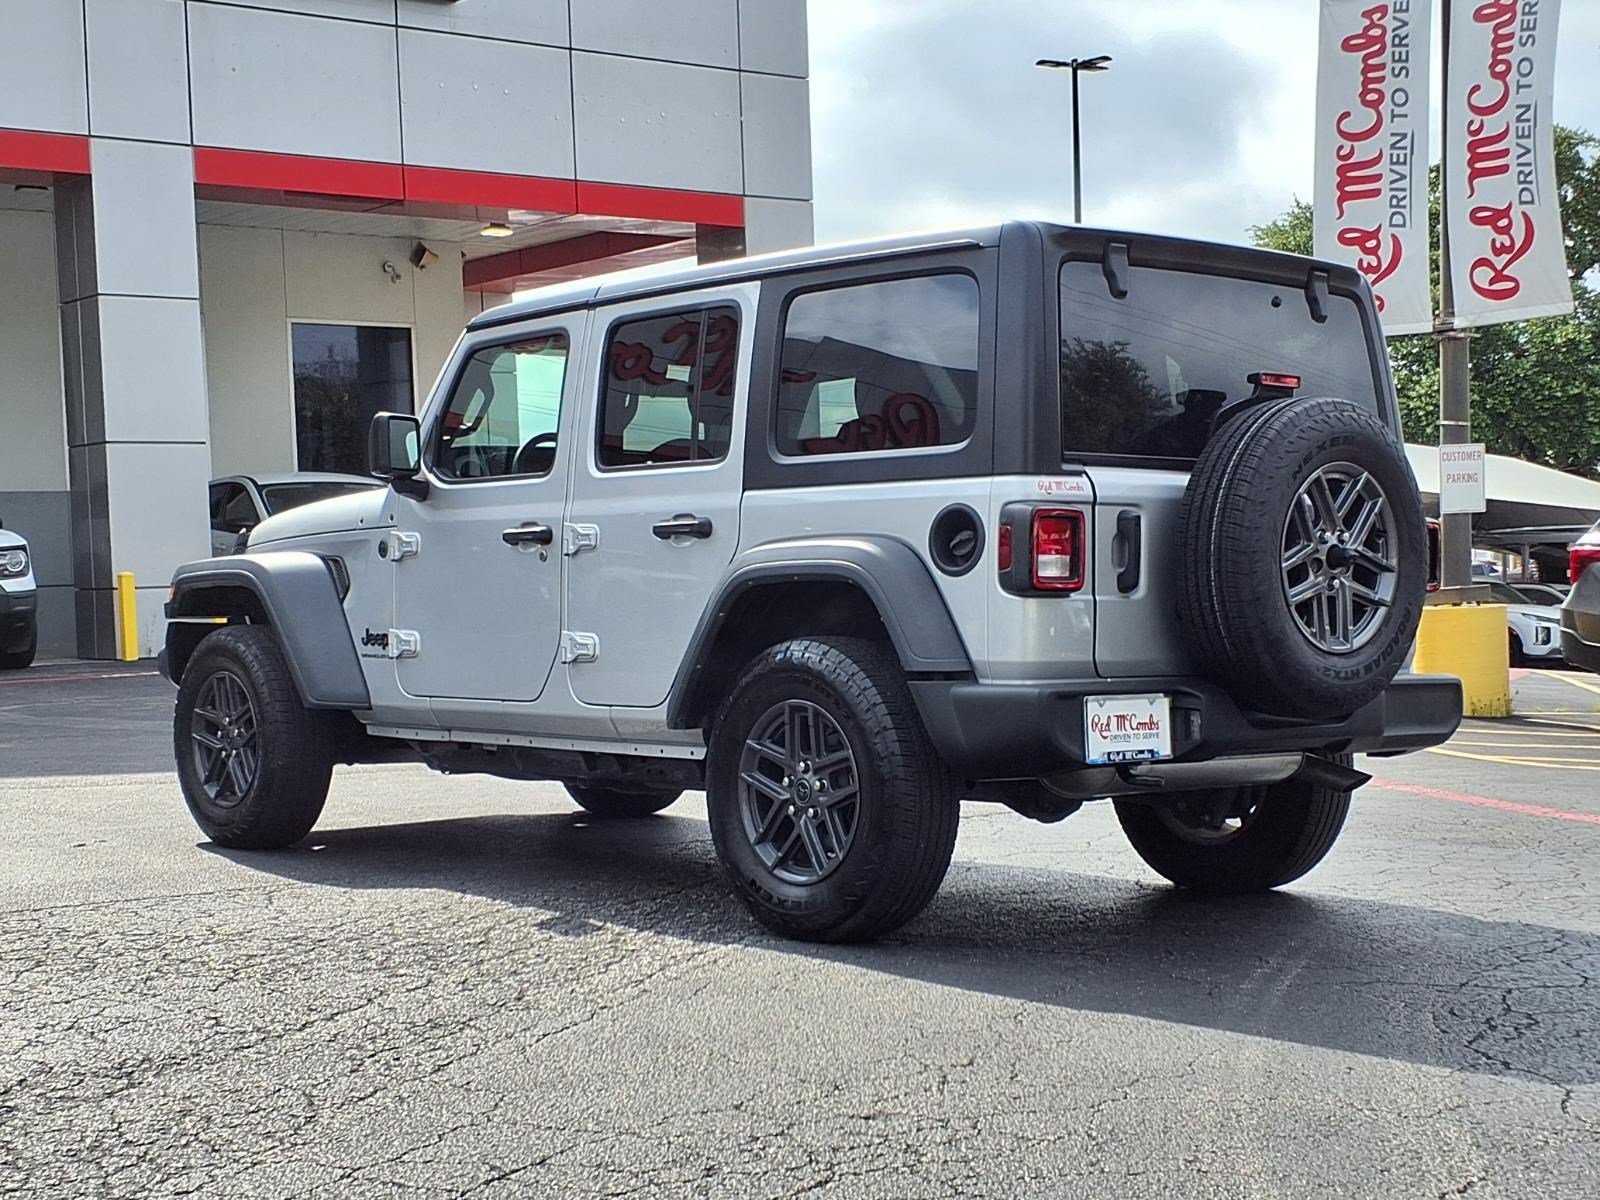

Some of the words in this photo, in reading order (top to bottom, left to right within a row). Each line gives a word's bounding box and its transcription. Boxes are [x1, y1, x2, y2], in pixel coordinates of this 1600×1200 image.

[1391, 0, 1410, 79] SERVE
[1519, 0, 1540, 48] SER
[1516, 57, 1534, 95] TO
[1336, 4, 1388, 220] McCombs
[1390, 88, 1409, 124] TO
[1467, 0, 1517, 199] McComb
[1516, 103, 1535, 207] DRIVEN
[1389, 131, 1409, 229] DRIVEN
[1469, 201, 1534, 300] Red
[1441, 450, 1482, 462] CUSTOMER
[1446, 472, 1479, 484] PARKING
[361, 628, 388, 650] Jeep
[1091, 713, 1112, 740] Red
[1113, 712, 1160, 732] McCombs
[1109, 733, 1132, 741] DRIVEN
[1141, 732, 1160, 740] SERVE
